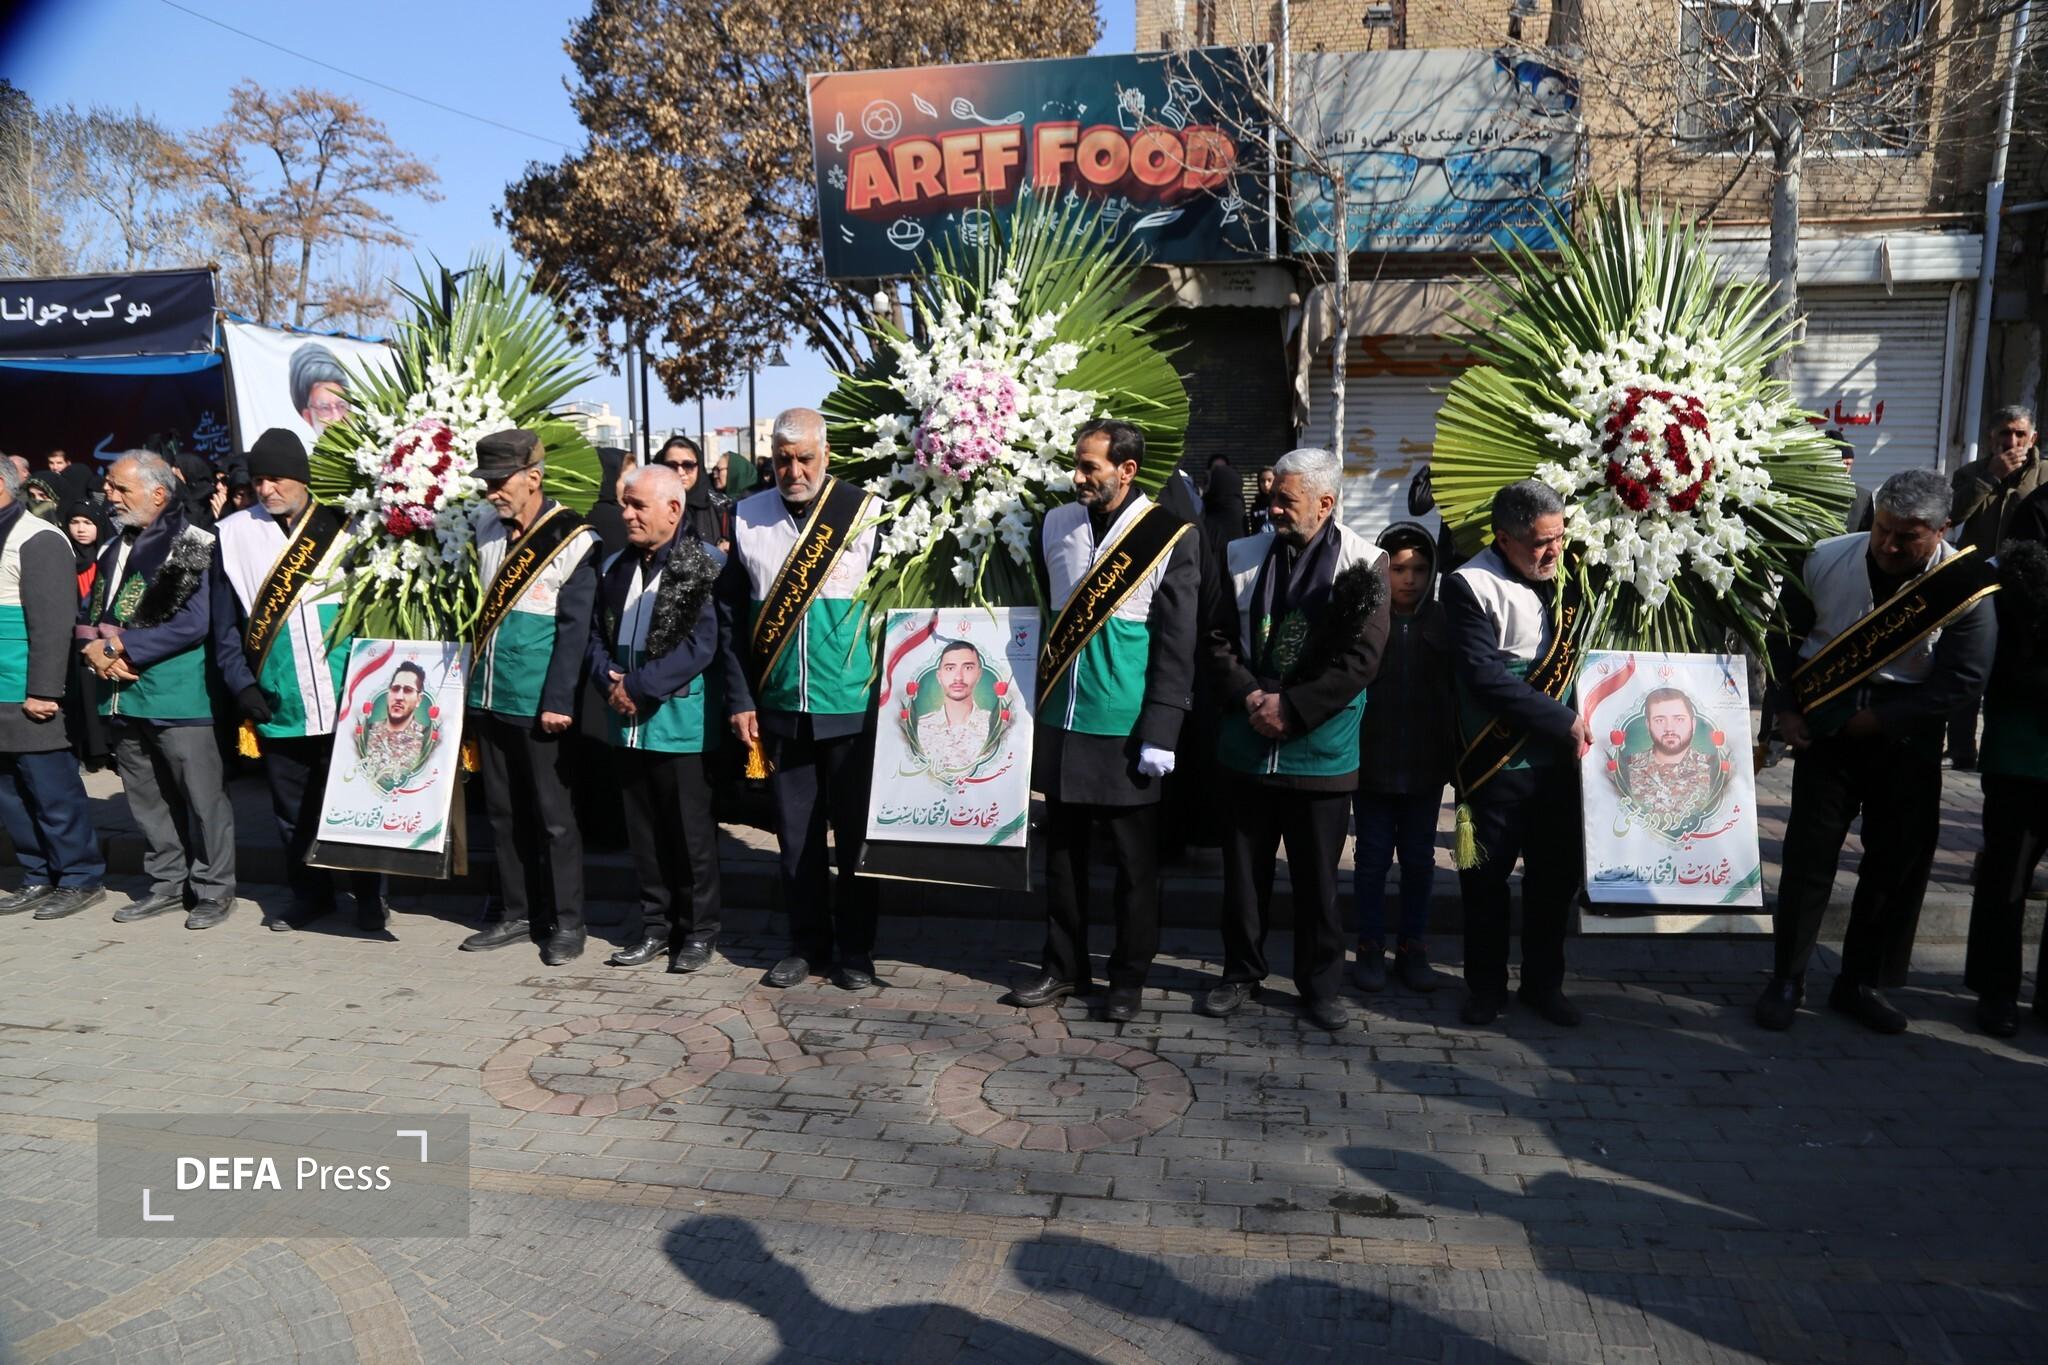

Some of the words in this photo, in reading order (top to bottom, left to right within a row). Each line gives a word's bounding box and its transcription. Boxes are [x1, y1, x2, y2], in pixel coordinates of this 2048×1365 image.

[1361, 135, 1368, 149] و
[1370, 129, 1399, 148] طبی
[1402, 129, 1428, 147] های
[1431, 128, 1463, 145] عینک
[1466, 129, 1500, 146] انواع
[846, 124, 1026, 212] AREF
[1033, 121, 1239, 191] FOOD
[791, 566, 808, 590] علی
[785, 581, 804, 603] ابن
[776, 596, 795, 626] موسی
[955, 751, 1013, 795] شهید
[383, 811, 422, 834] شهادت
[876, 803, 919, 826] ماست
[919, 798, 950, 827] افتخار
[949, 802, 1000, 828] شهادت
[1679, 804, 1743, 851] شهید
[1645, 855, 1678, 886] افتخار
[1678, 858, 1732, 886] شهادت
